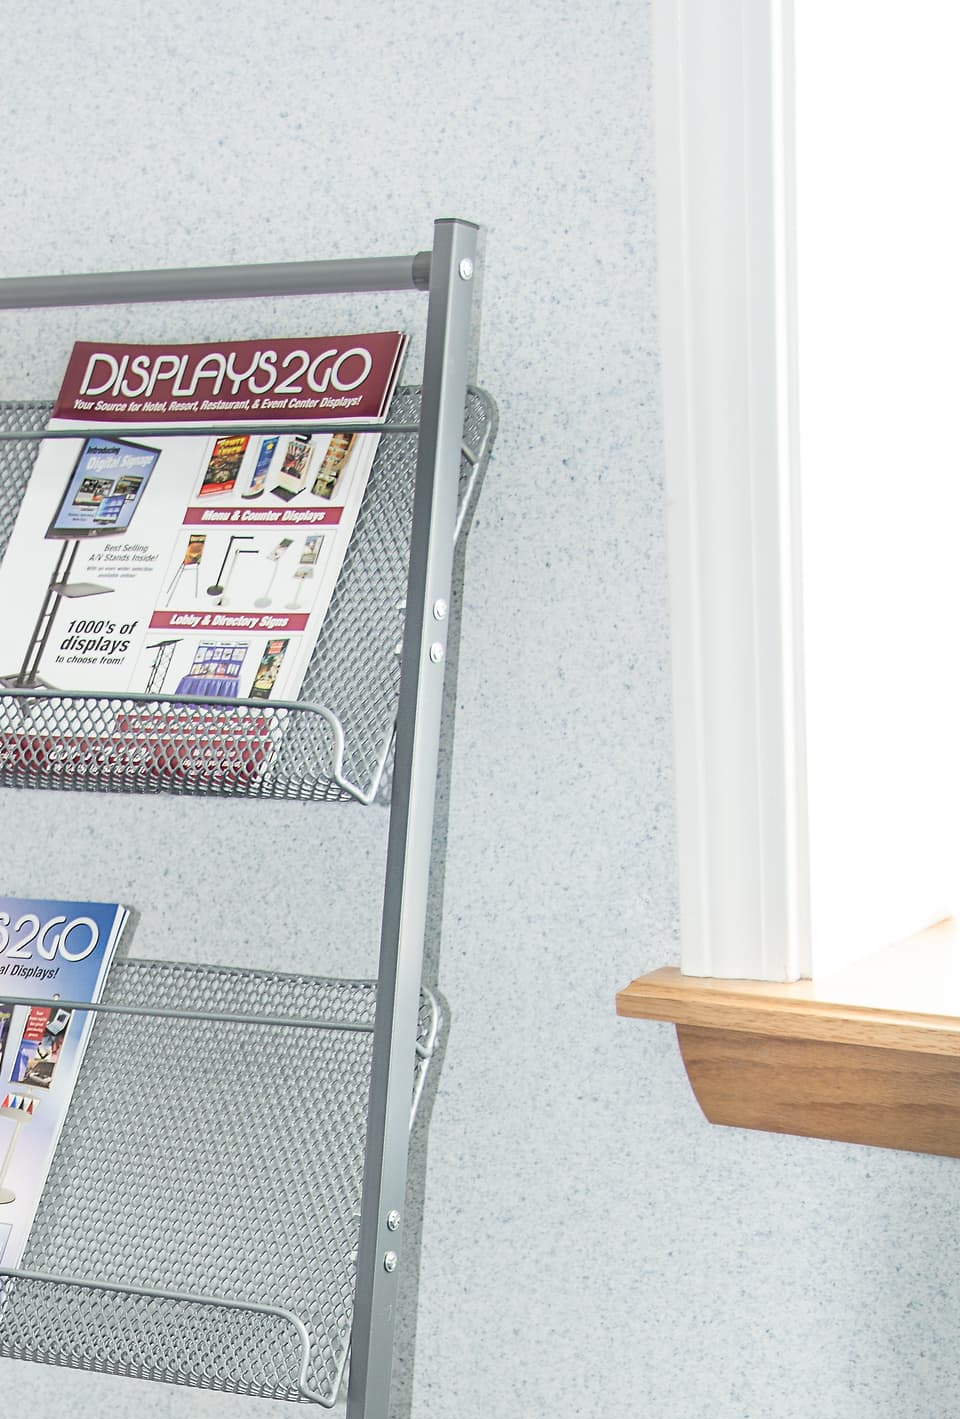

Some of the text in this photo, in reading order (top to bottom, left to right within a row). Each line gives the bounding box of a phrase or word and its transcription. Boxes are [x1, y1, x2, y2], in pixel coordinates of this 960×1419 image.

[80, 348, 372, 397] DISPLAYS2GO
[73, 395, 363, 414] Your Source for Hotel, Resort, Restaurant, & Event Center Displays!
[201, 510, 326, 523] Menu & Counter Displays
[104, 543, 149, 553] Best Selling
[67, 620, 139, 635] 1000's of
[169, 614, 290, 628] Lobby & Directory Signs
[60, 636, 131, 655] displays
[56, 655, 125, 665] to choose from!
[10, 964, 60, 980] Displays!
